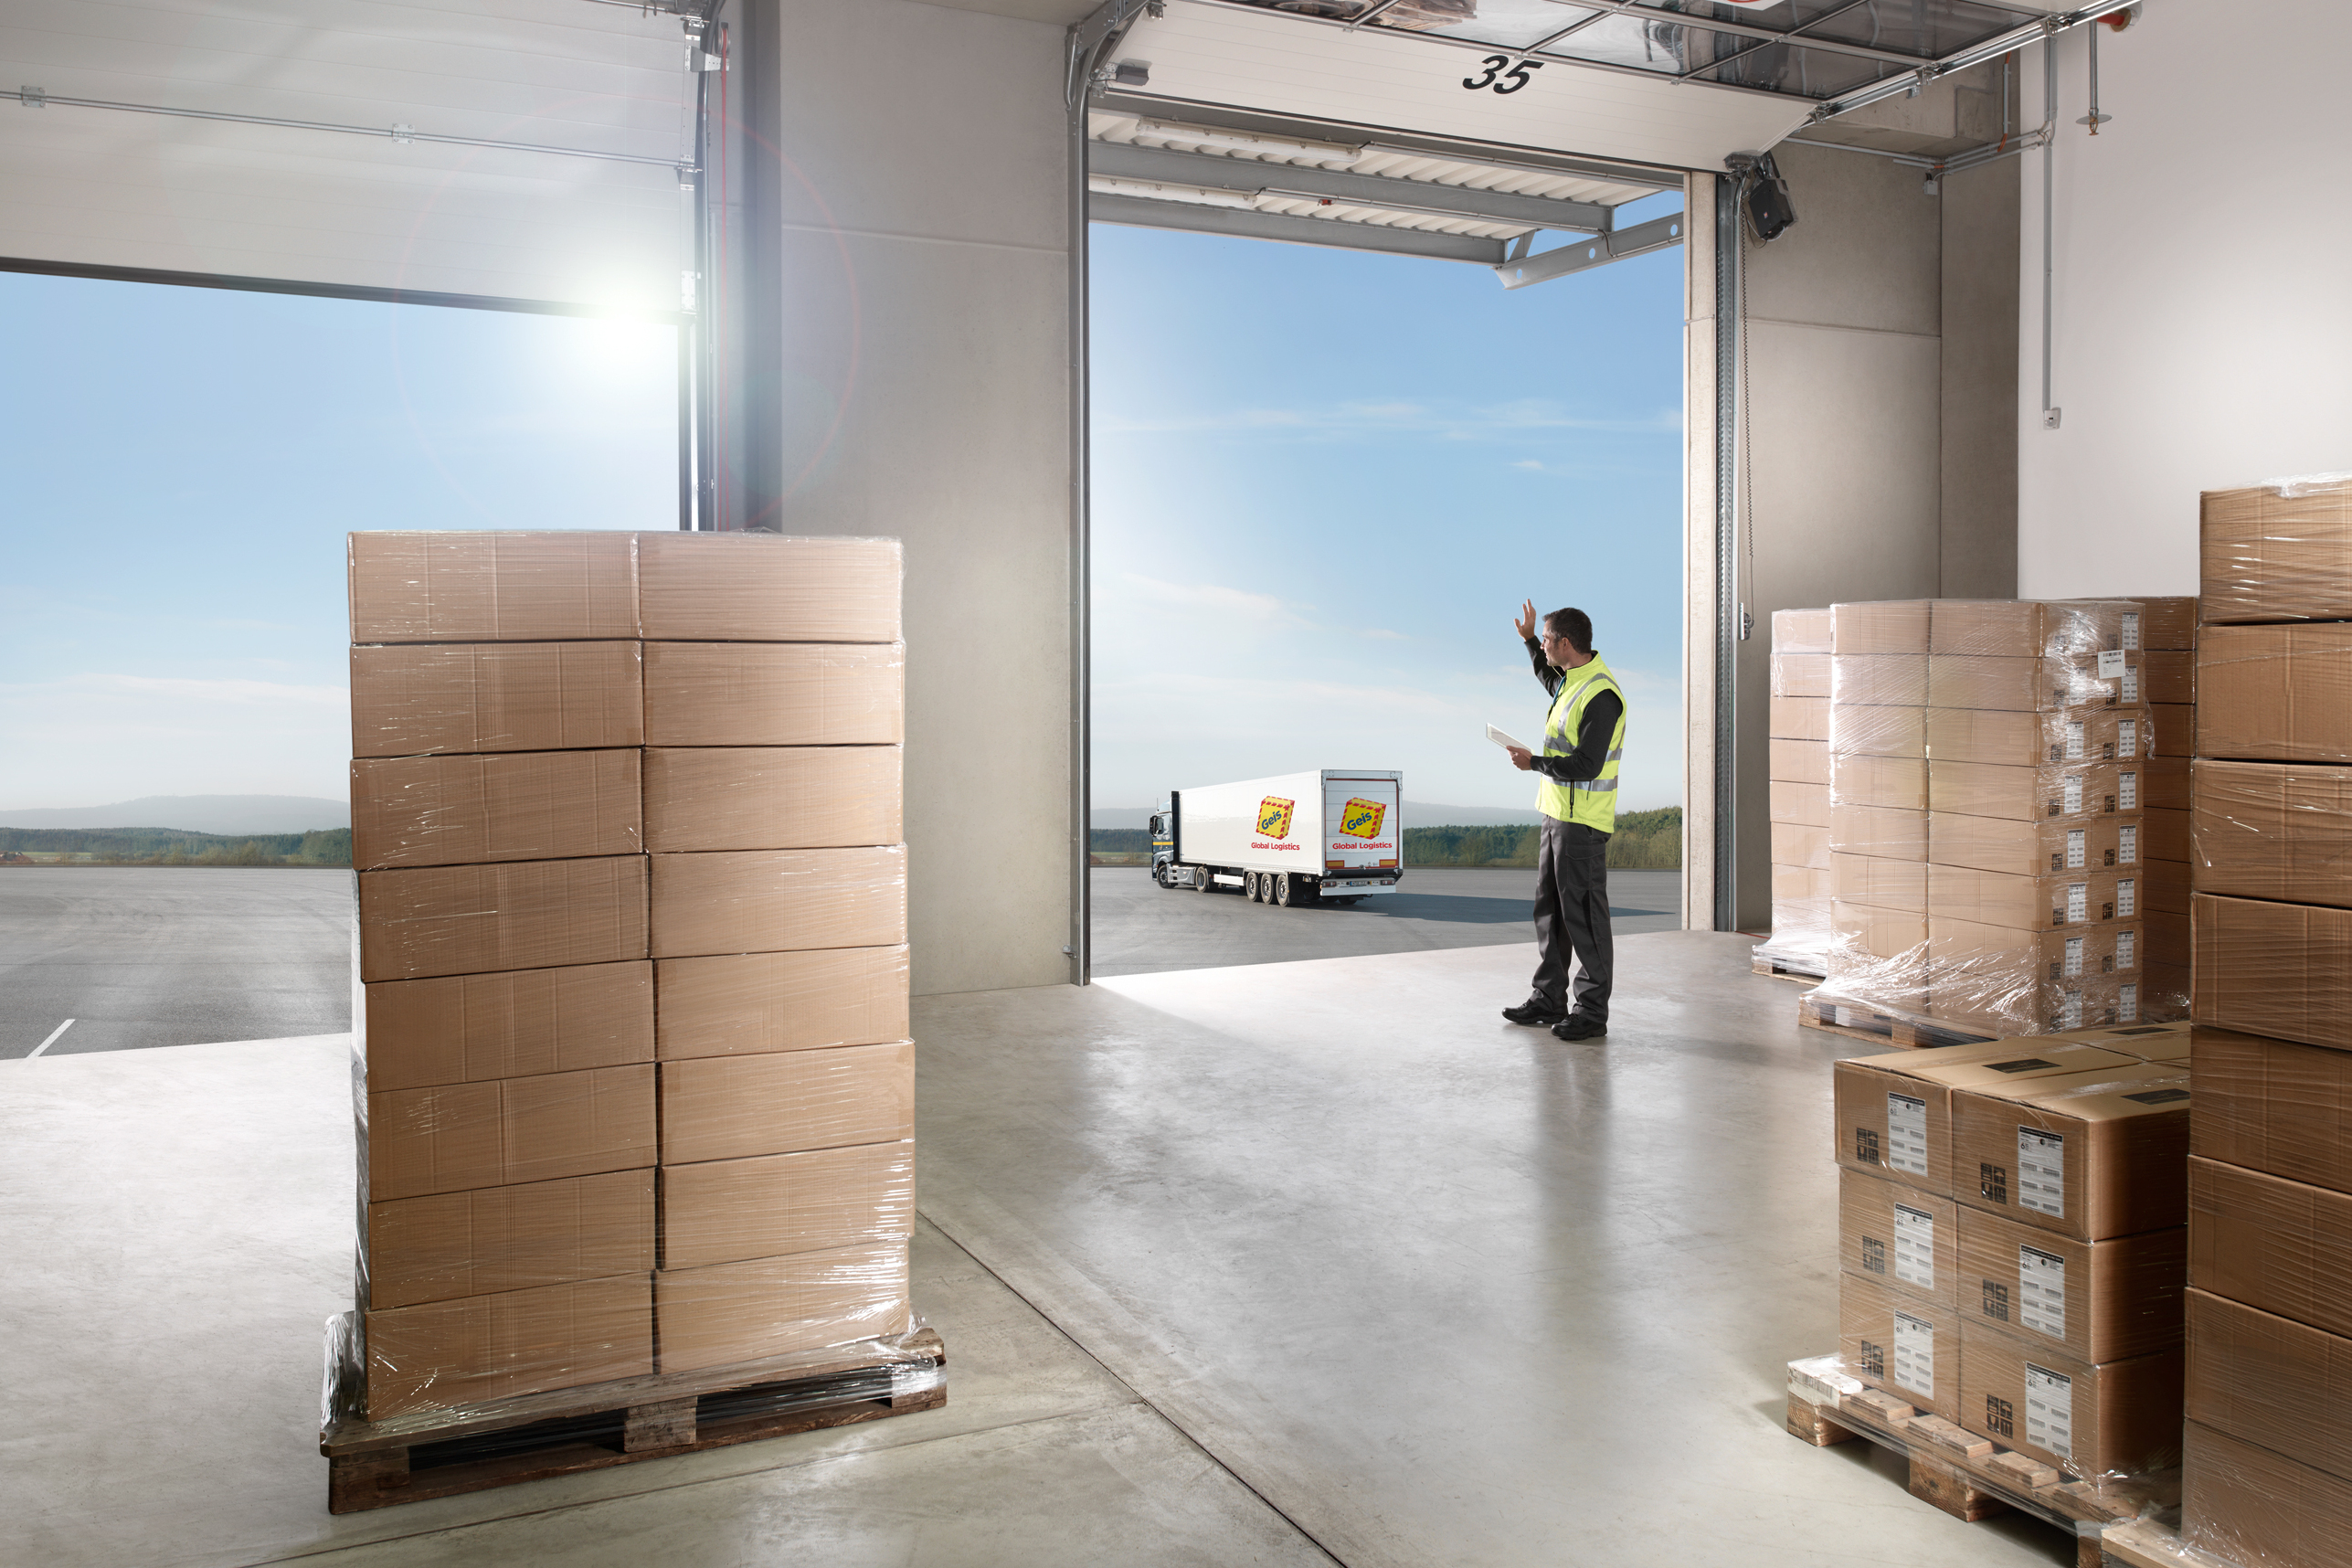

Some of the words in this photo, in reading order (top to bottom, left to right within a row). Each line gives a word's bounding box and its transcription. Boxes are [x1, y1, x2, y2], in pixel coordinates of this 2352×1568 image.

[1462, 54, 1545, 95] 35
[1261, 810, 1283, 831] Geis
[1346, 811, 1372, 831] Geis
[1251, 842, 1269, 850] Global
[1270, 842, 1300, 851] Logistics
[1359, 842, 1393, 850] Logistics
